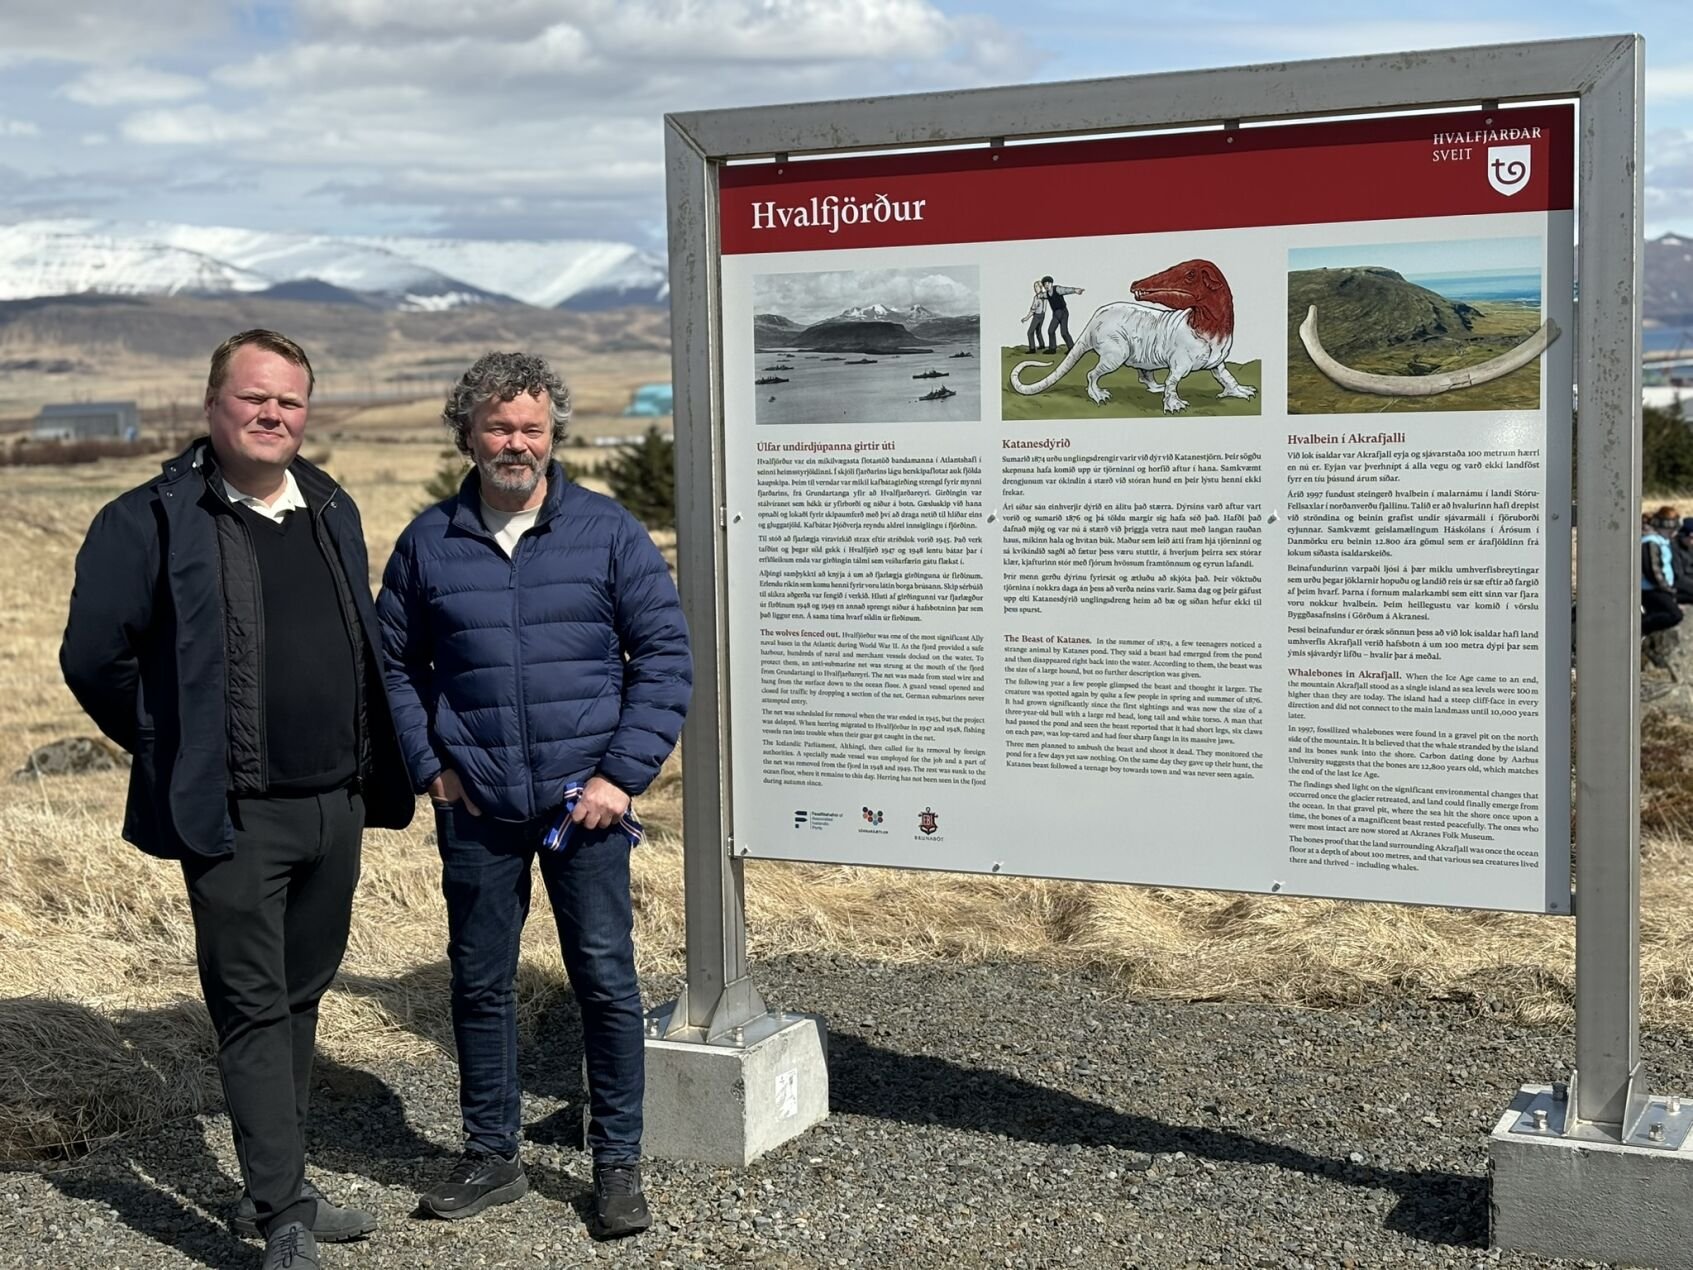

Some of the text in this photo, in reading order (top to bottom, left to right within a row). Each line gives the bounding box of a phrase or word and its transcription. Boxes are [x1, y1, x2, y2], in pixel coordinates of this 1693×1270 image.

[1433, 127, 1542, 145] HVALFJARÐAR
[1432, 148, 1473, 162] SVEIT
[751, 193, 926, 234] Hvalfjörður
[1002, 437, 1071, 451] Katanesdýrið
[1287, 432, 1339, 444] Hvalbein
[1347, 431, 1405, 446] Akrafjalli
[756, 440, 895, 453] Úlfar undirdjúpanna girtir úti
[1001, 453, 1031, 462] Sumarið
[1030, 453, 1045, 464] 1874
[1045, 453, 1062, 462] urðu
[1062, 452, 1119, 464] unglingsdrengir
[1119, 452, 1137, 461] varir
[1137, 452, 1148, 461] við
[1161, 452, 1173, 461] við
[1224, 451, 1239, 460] Þeir
[1239, 451, 1262, 462] sögðu
[1287, 449, 1301, 458] Við
[1301, 449, 1314, 458] lok
[1356, 448, 1392, 460] Akrafjall
[1392, 448, 1409, 460] eyja
[1410, 451, 1421, 460] og
[1482, 448, 1516, 457] metrum
[1516, 447, 1540, 457] hærri
[1323, 461, 1346, 472] Eyjan
[1412, 460, 1427, 469] alla
[1429, 463, 1449, 472] vegu
[1450, 463, 1461, 472] og
[1463, 460, 1482, 469] varð
[1484, 460, 1503, 469] ekki
[1505, 460, 1540, 469] landföst
[1001, 476, 1043, 486] drengjunum
[1093, 475, 1113, 484] stærð
[1114, 475, 1126, 484] við
[1152, 475, 1172, 483] hund
[1184, 475, 1199, 485] þeir
[1220, 474, 1243, 483] henni
[1244, 474, 1262, 483] ekki
[1286, 473, 1302, 484] fyrr
[1306, 491, 1323, 499] 1997
[1324, 488, 1355, 497] fundust
[1356, 488, 1393, 499] steingerð
[1394, 488, 1429, 497] hvalbein
[1490, 488, 1512, 497] landi
[1287, 547, 1312, 556] lokum
[1003, 604, 1018, 614] þess
[1003, 633, 1019, 642] The
[1021, 633, 1044, 643] Beast
[1045, 633, 1054, 643] of
[1105, 637, 1117, 645] the
[1180, 638, 1194, 646] few
[1195, 640, 1228, 649] teenagers
[1229, 639, 1255, 648] noticed
[1288, 666, 1343, 677] Whalebones
[1345, 668, 1355, 678] in
[1405, 671, 1428, 680] When
[1430, 672, 1443, 680] the
[1445, 672, 1456, 681] Ice
[1459, 673, 1474, 683] Age
[1287, 689, 1311, 700] higher
[1312, 690, 1330, 699] than
[1331, 690, 1347, 701] they
[1386, 692, 1401, 701] The
[1402, 693, 1426, 702] island
[1427, 693, 1442, 702] had
[1450, 695, 1470, 705] steep
[1472, 695, 1505, 704] cliff-face
[1507, 696, 1516, 705] in
[1517, 699, 1539, 708] every
